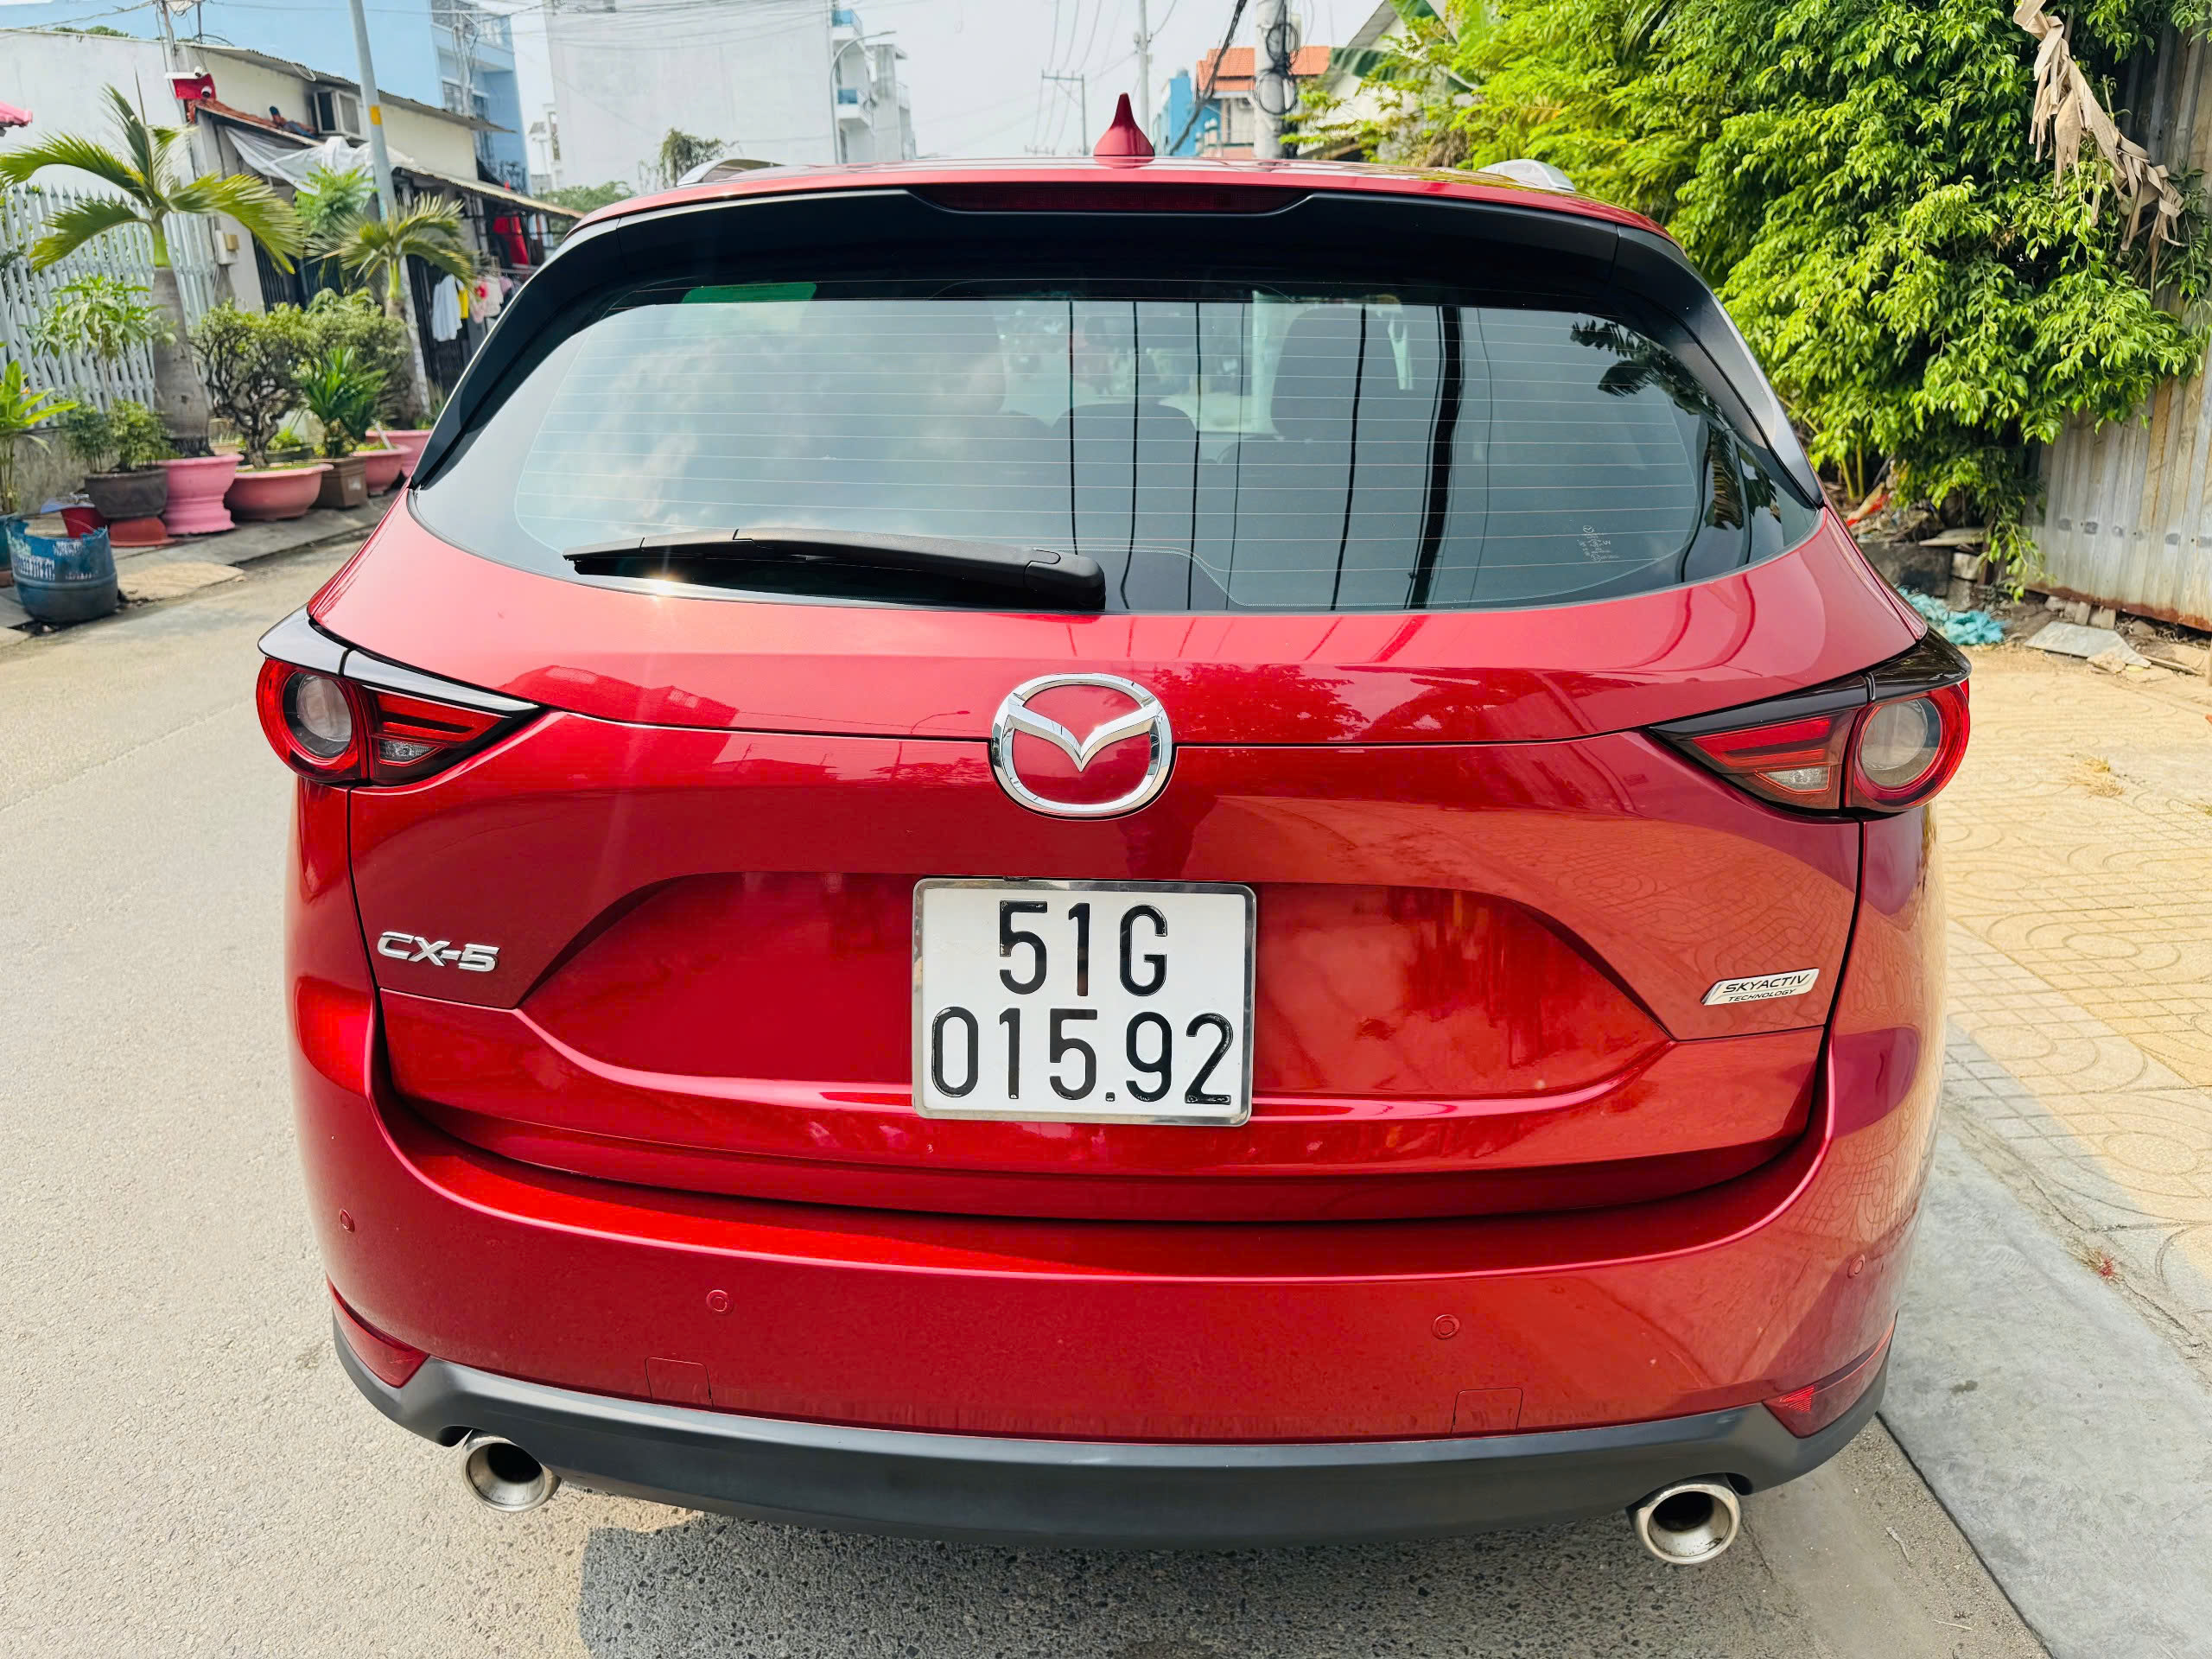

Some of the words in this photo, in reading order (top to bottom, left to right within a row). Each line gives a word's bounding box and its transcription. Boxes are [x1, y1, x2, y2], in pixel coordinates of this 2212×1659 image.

[377, 931, 500, 972] CX-5
[999, 899, 1168, 997] 51G
[1723, 973, 1810, 994] SKYACTIV
[1728, 988, 1797, 1002] TECHNOLOGY
[931, 1006, 1234, 1106] 015.92
